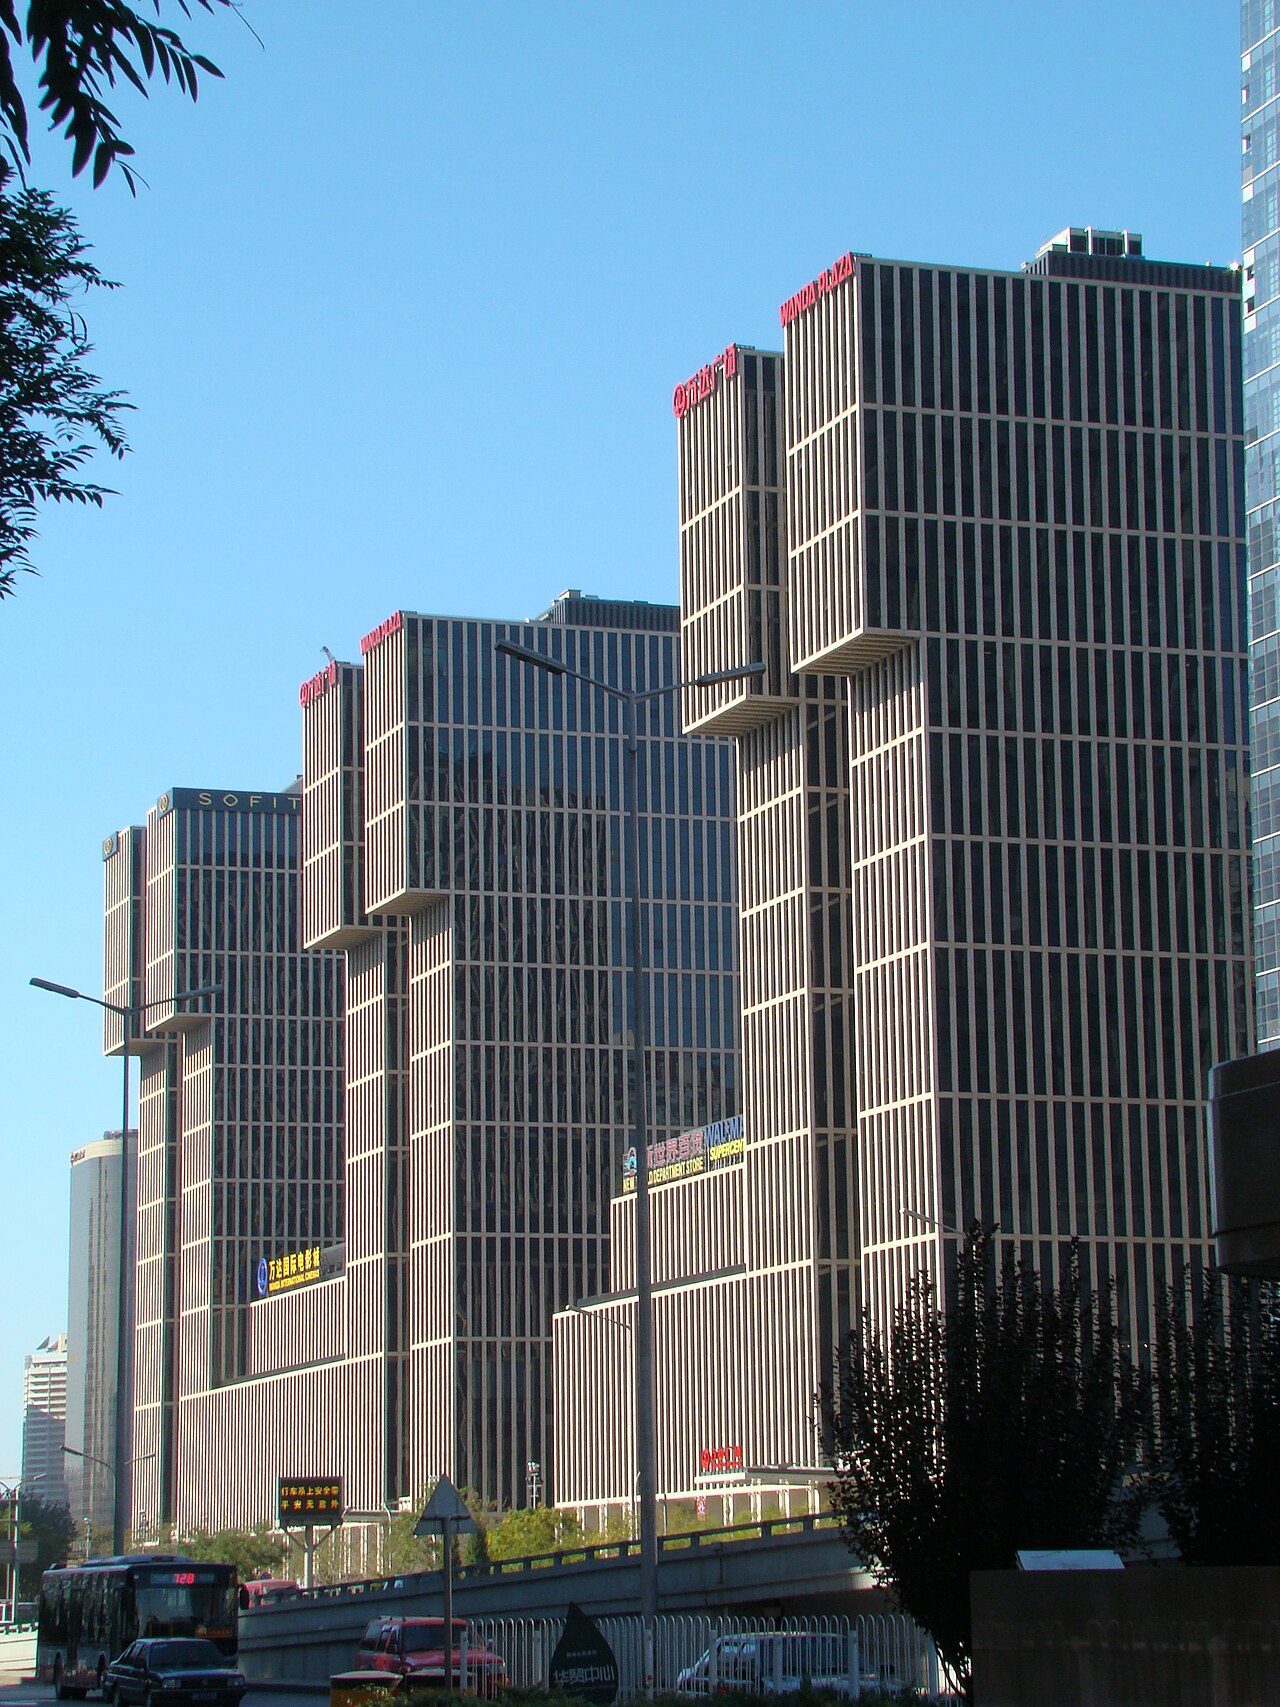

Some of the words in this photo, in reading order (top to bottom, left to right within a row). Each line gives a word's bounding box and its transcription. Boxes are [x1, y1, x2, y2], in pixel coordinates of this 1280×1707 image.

[779, 279, 816, 328] WANDA
[818, 251, 853, 298] PLAZA
[268, 1246, 320, 1280] 万达国际电影城
